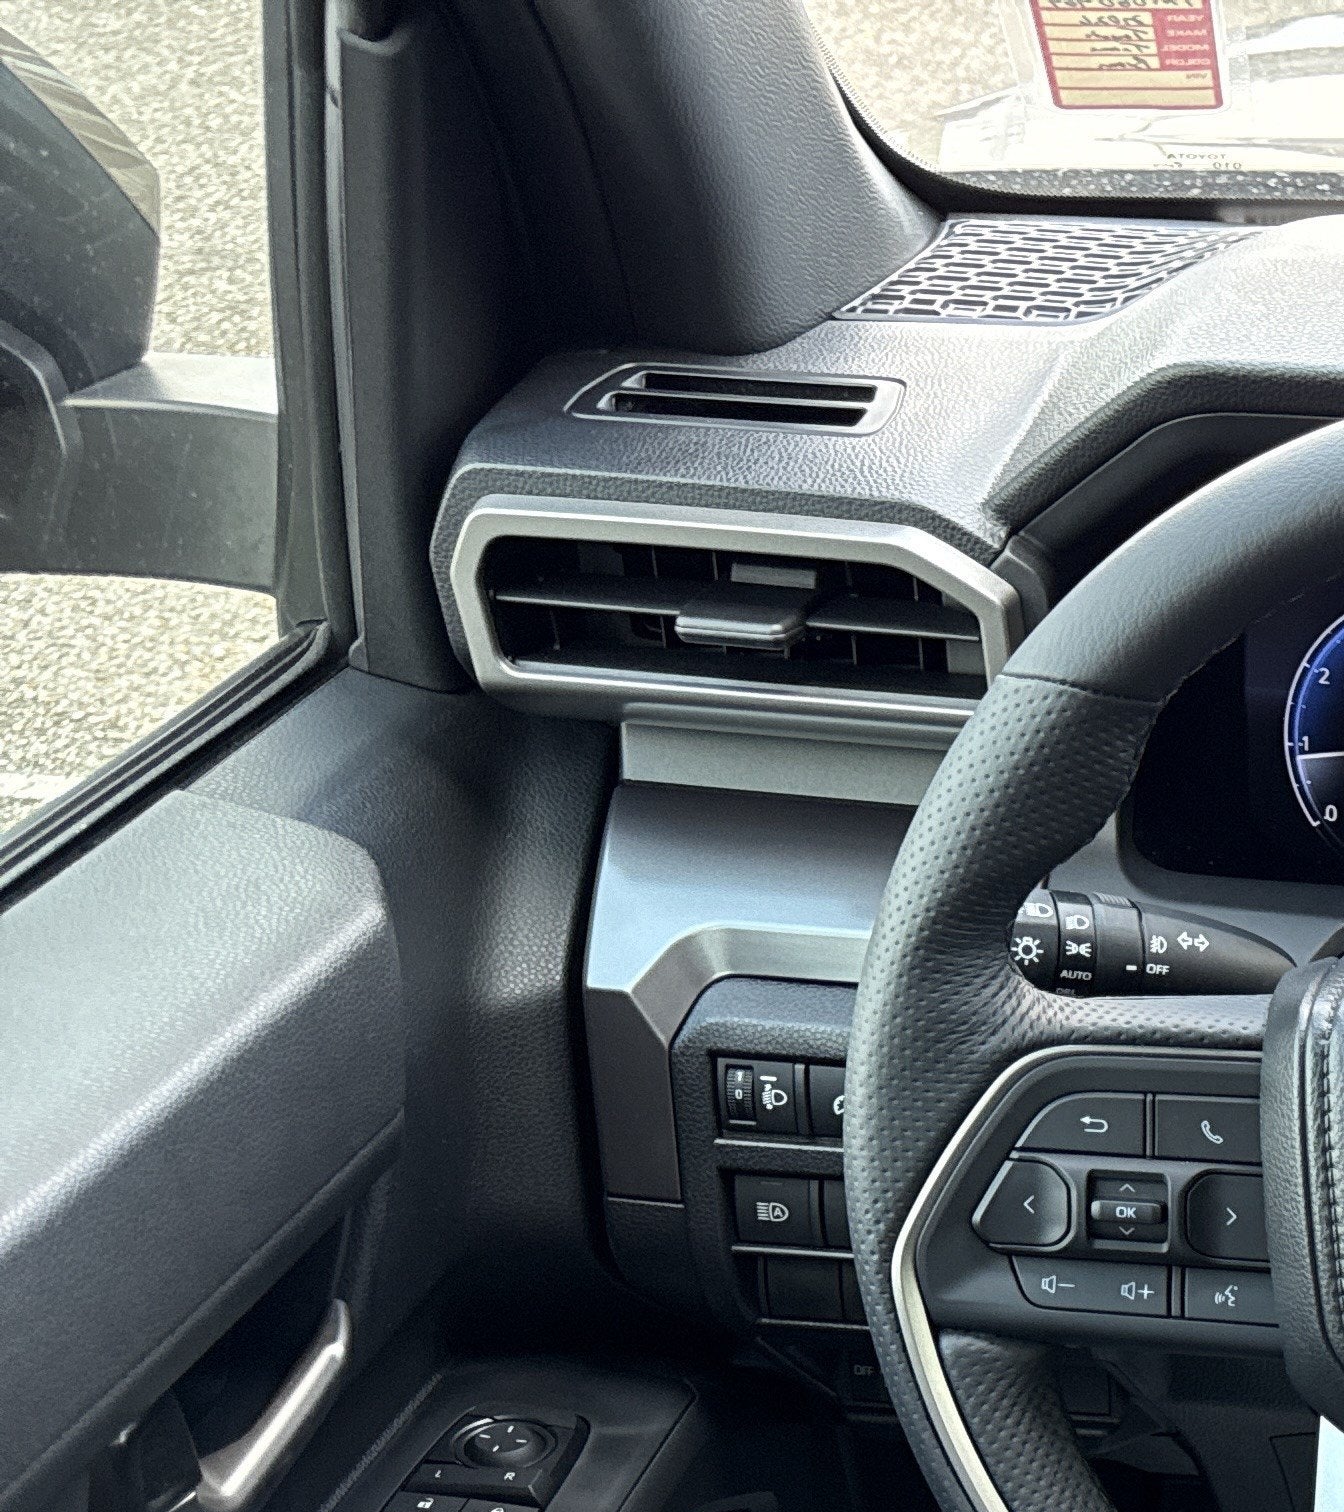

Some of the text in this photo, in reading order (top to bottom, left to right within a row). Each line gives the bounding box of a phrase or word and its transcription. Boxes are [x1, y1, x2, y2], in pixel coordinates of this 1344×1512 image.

[1318, 668, 1330, 685] 2
[1324, 805, 1337, 821] 0
[1060, 969, 1092, 980] AUTO
[1146, 963, 1170, 975] OFF
[1115, 1206, 1136, 1218] OK
